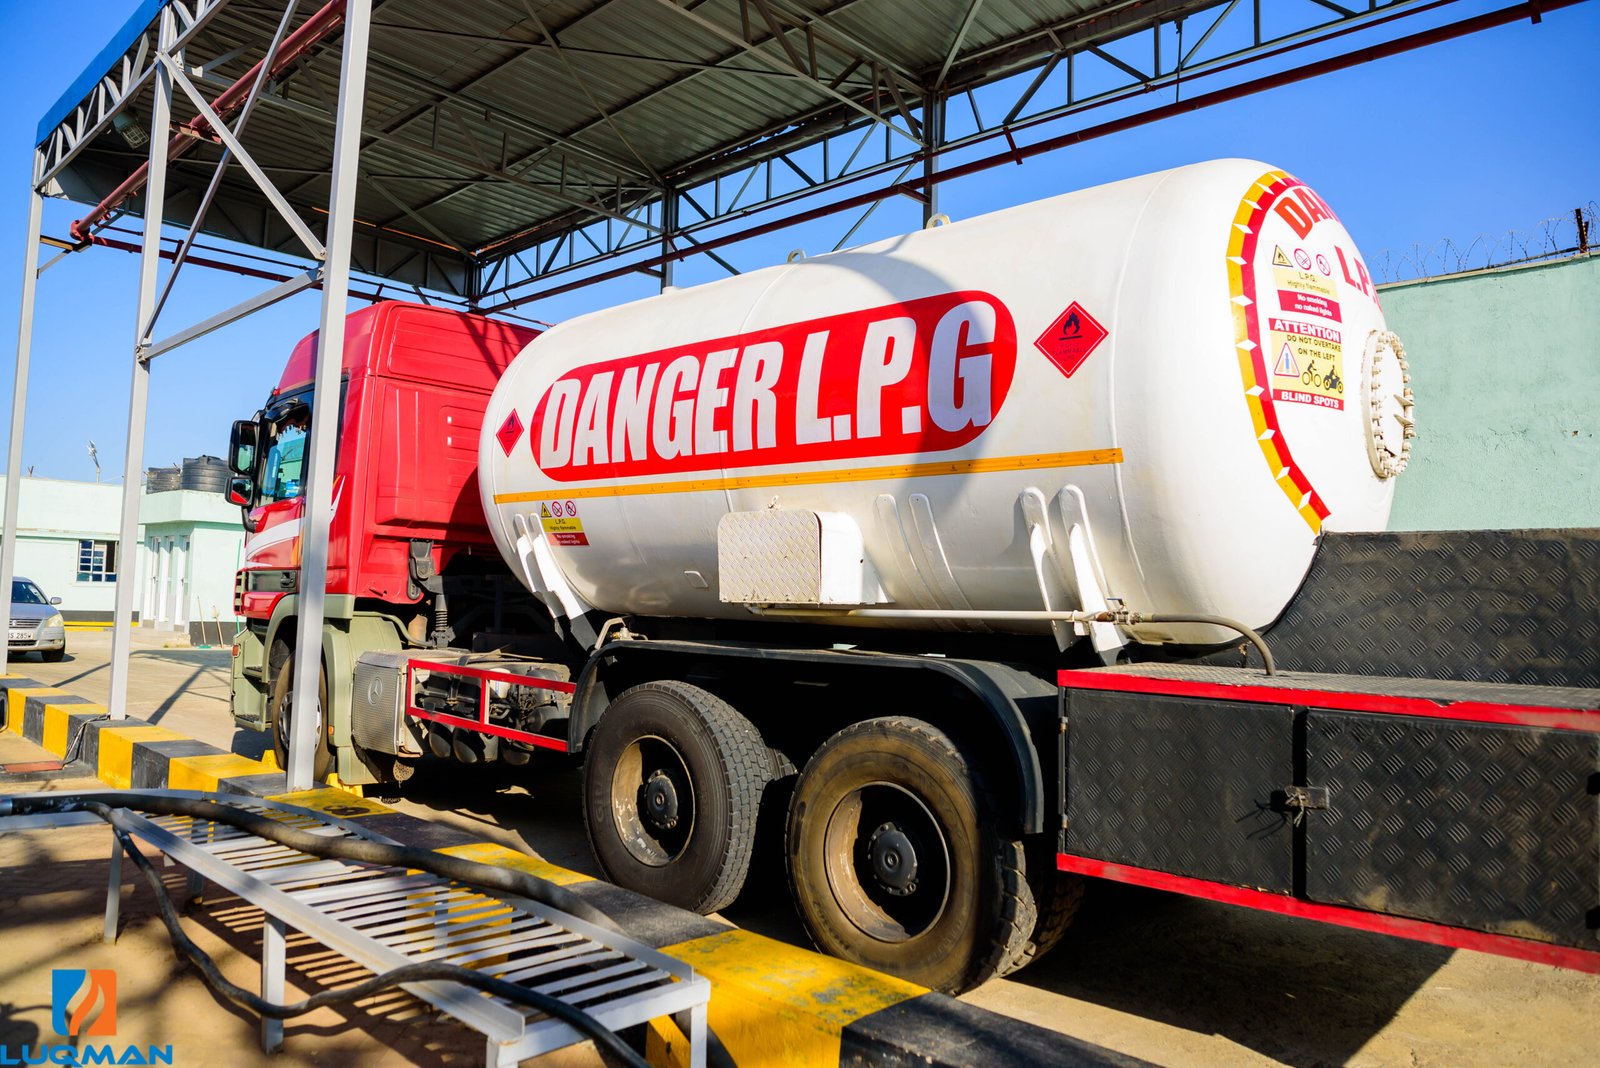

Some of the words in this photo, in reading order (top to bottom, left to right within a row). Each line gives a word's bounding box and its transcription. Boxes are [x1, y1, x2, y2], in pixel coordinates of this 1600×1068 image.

[1274, 319, 1340, 343] ATTENTION
[1287, 334, 1297, 342] DO
[1299, 336, 1312, 344] NOT
[1314, 339, 1341, 353] OVERTAKE
[1298, 347, 1308, 355] ON
[1309, 349, 1321, 358] THE
[1323, 352, 1335, 361] LEFT
[540, 342, 784, 469] DANGER
[796, 301, 996, 445] L.P.G
[1281, 391, 1312, 403] BLIND
[1313, 395, 1339, 409] SPOTS
